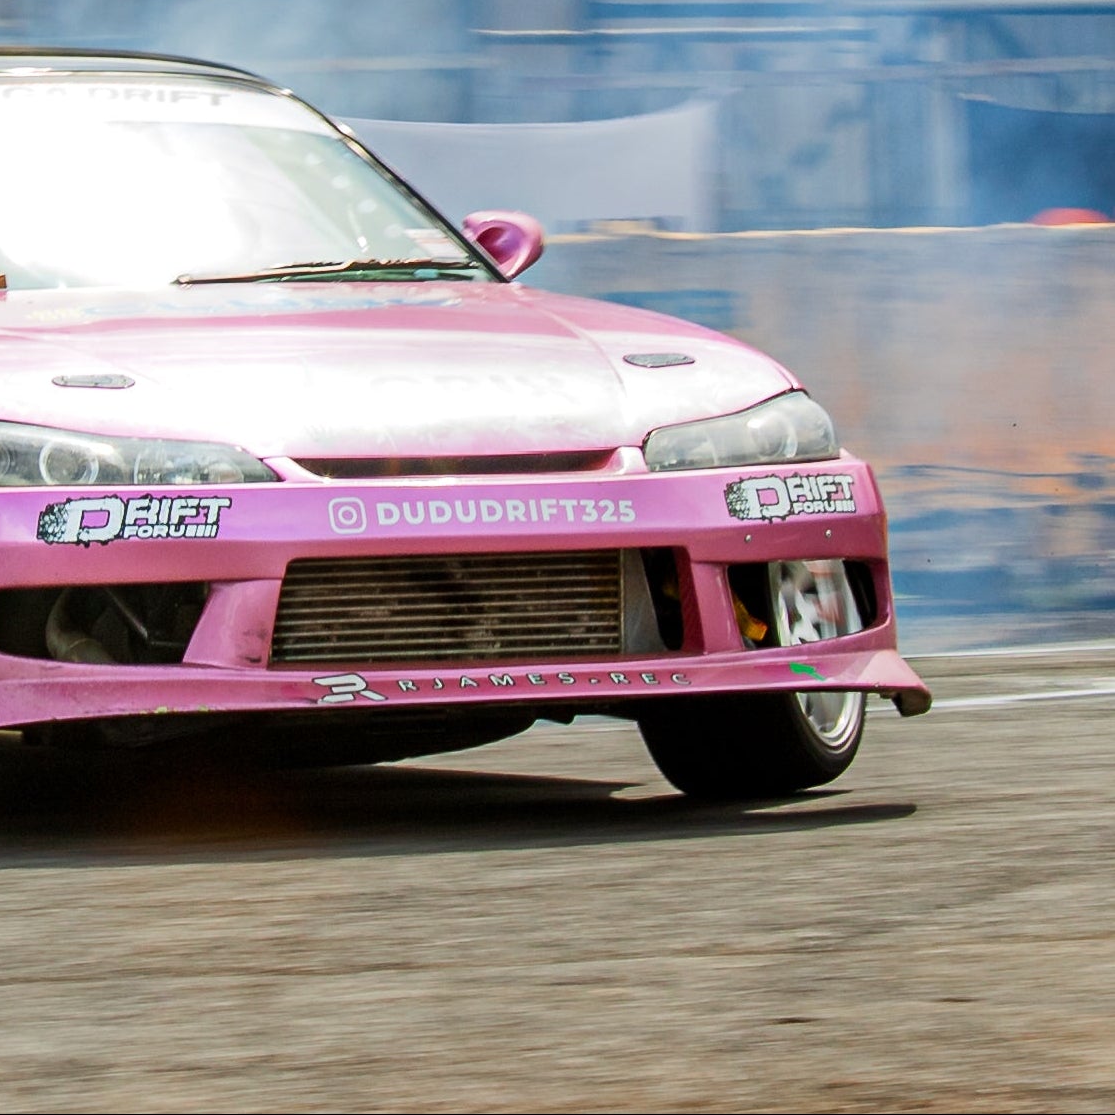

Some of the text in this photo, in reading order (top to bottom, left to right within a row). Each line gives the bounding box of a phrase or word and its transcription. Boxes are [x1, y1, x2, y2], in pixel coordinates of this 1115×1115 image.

[376, 499, 637, 526] DUDUDRIFT325
[726, 474, 854, 522] DRIFT
[38, 494, 232, 546] DRIFT
[397, 671, 692, 692] RJAMES.REC
